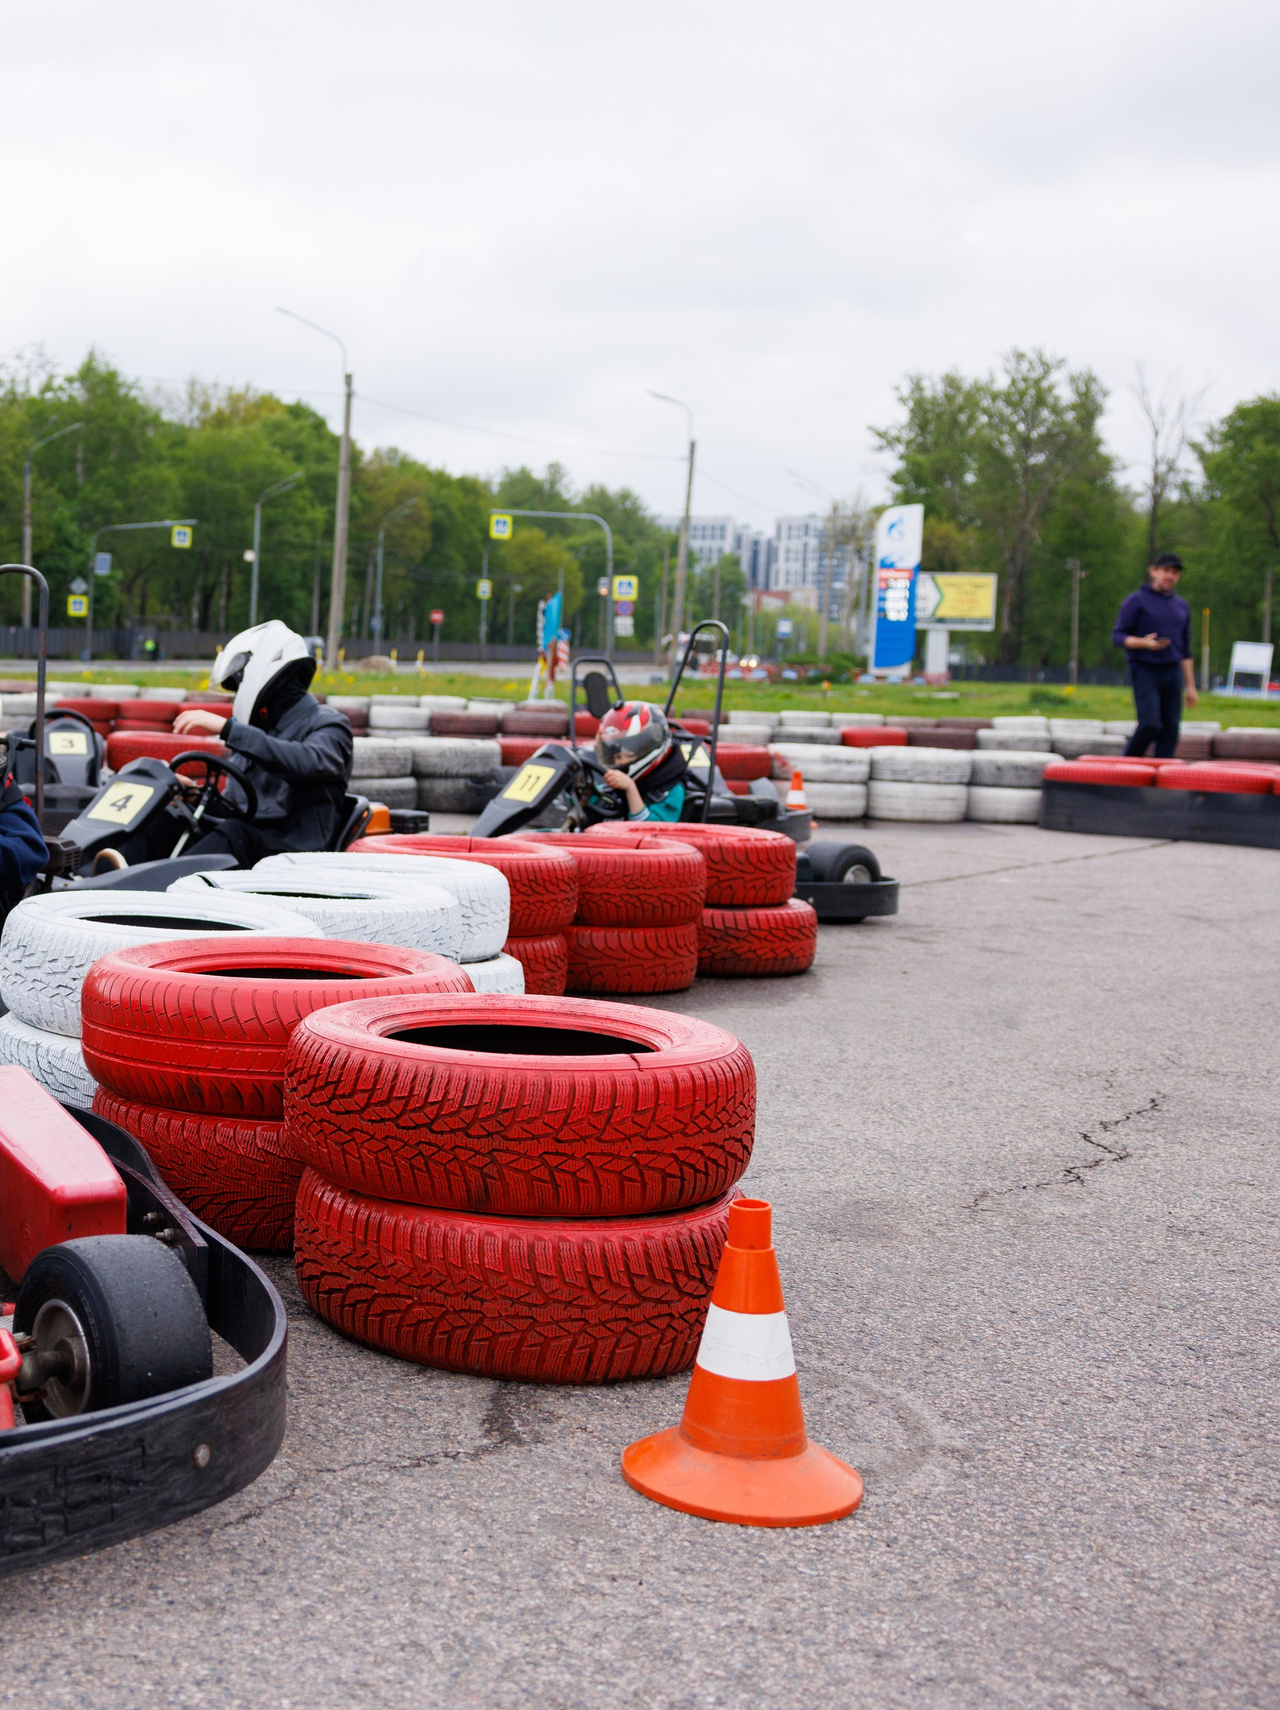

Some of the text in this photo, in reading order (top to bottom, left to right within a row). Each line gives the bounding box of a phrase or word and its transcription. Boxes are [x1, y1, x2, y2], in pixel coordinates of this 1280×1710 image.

[61, 738, 74, 749] 3
[520, 774, 540, 792] 11
[110, 794, 134, 811] 4
